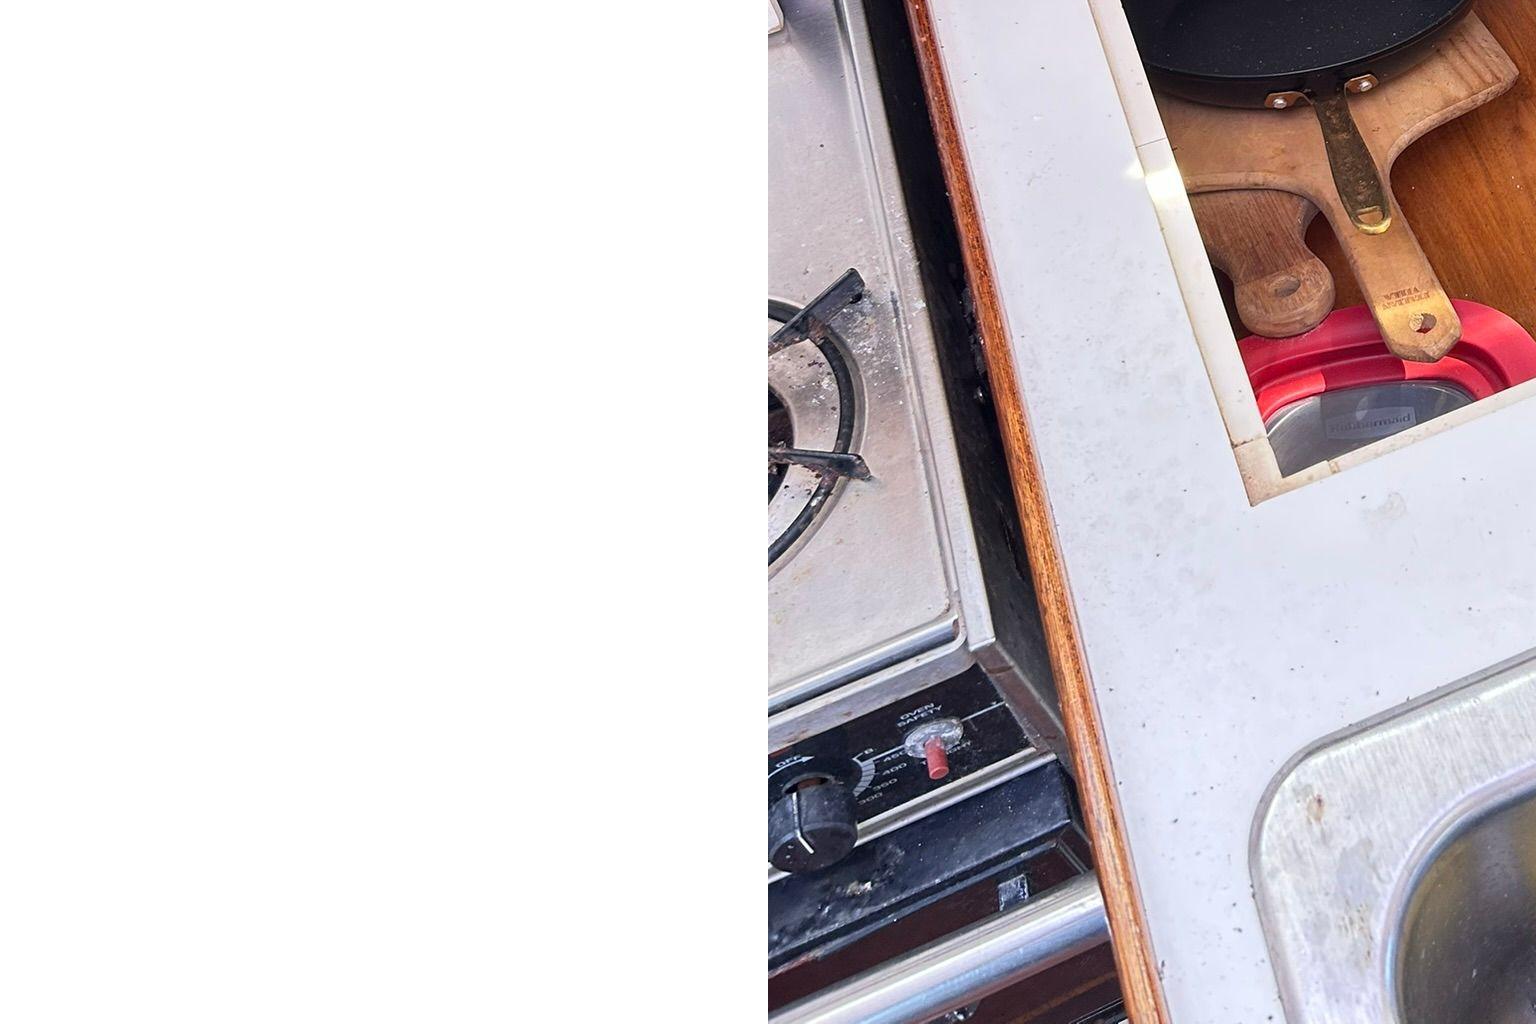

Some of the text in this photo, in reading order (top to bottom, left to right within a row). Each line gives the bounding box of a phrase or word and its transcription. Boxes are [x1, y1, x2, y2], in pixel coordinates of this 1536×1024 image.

[897, 705, 942, 727] SAFETY
[900, 703, 935, 720] OVEN
[776, 755, 802, 767] OFF
[882, 763, 907, 776] 400
